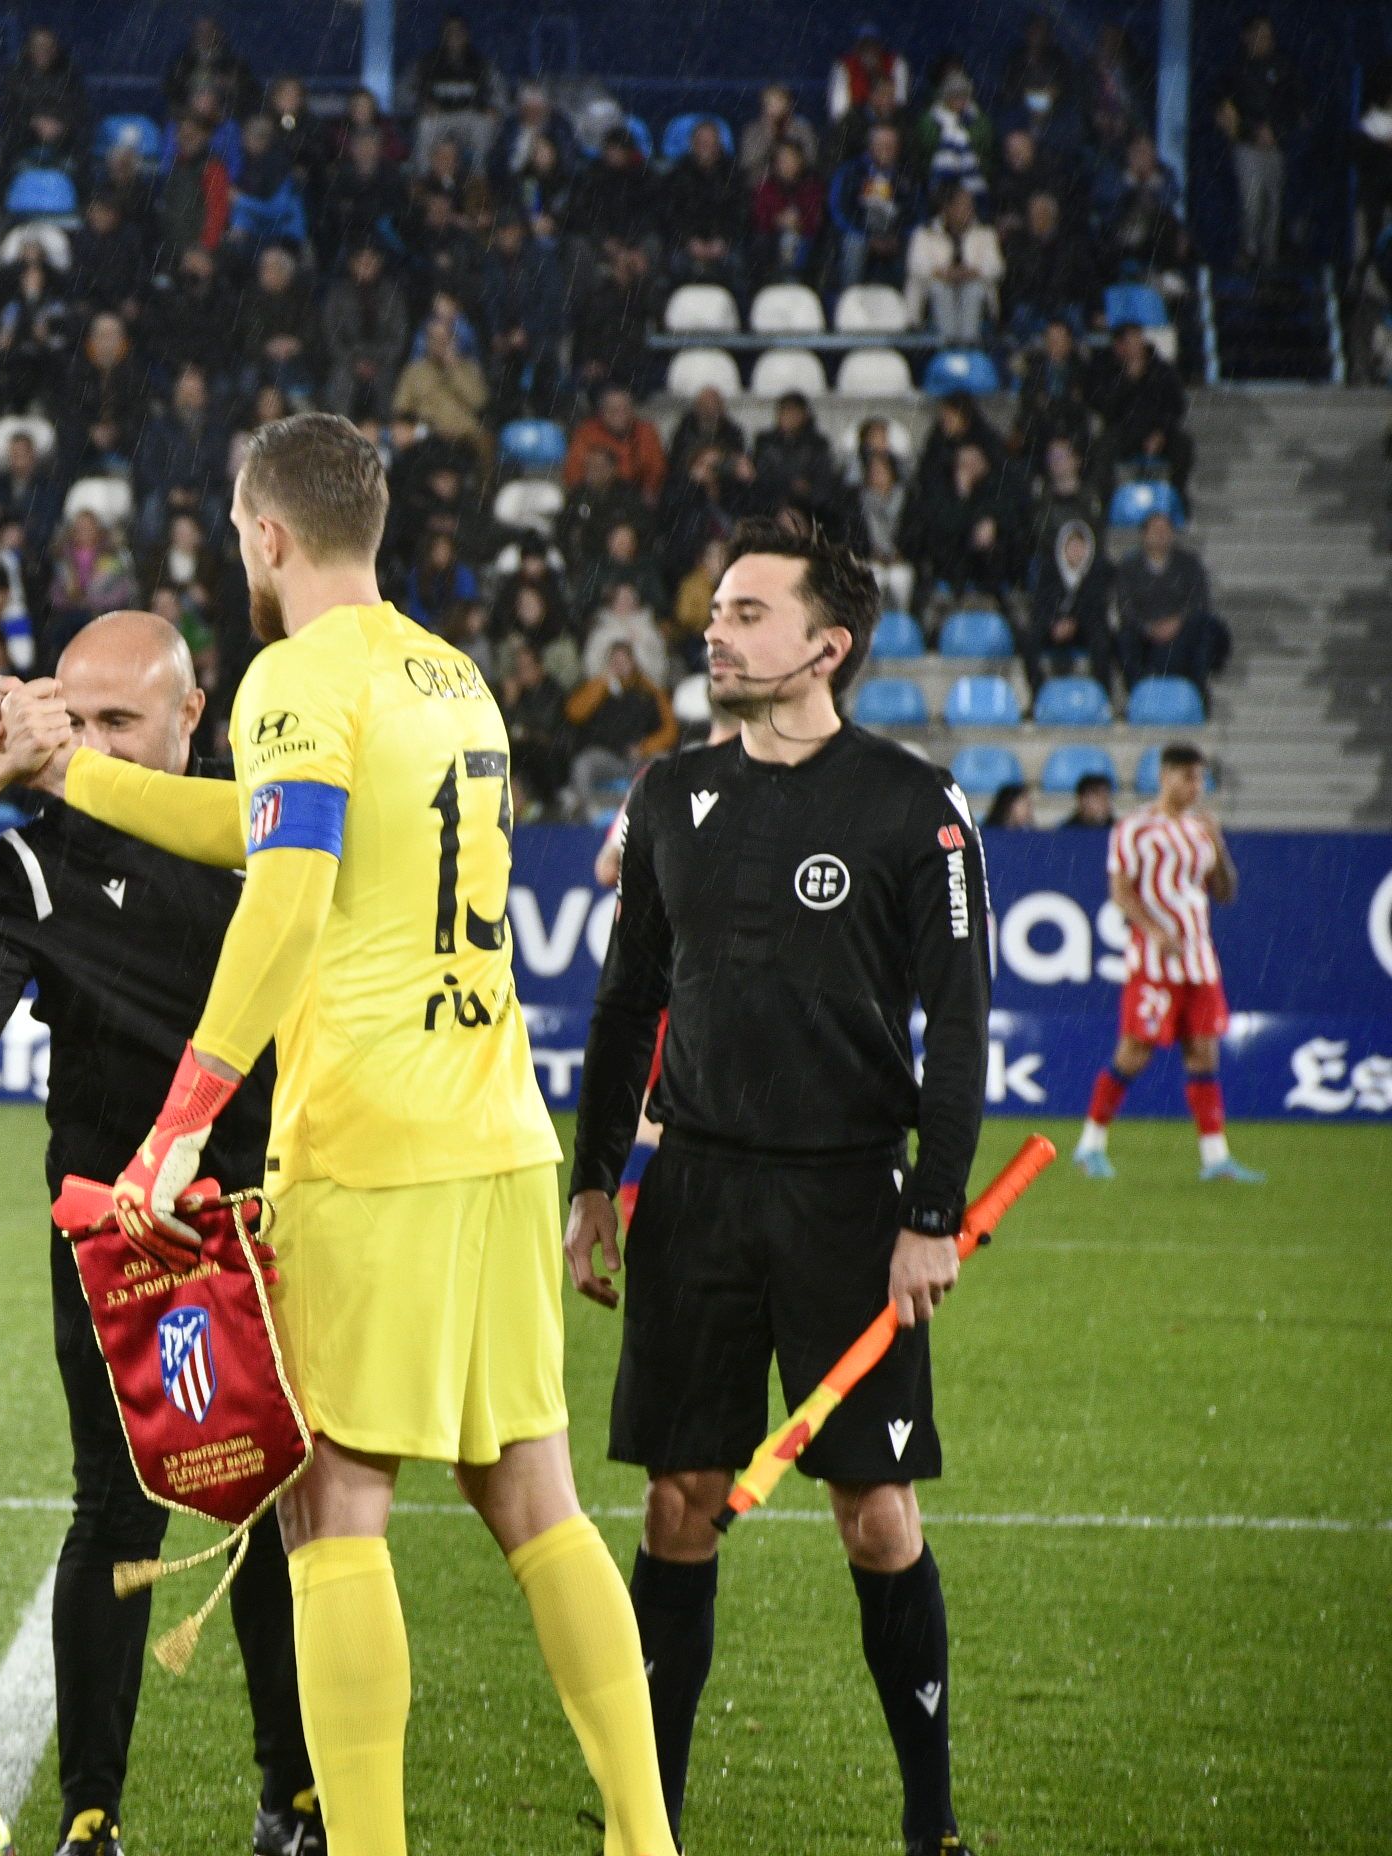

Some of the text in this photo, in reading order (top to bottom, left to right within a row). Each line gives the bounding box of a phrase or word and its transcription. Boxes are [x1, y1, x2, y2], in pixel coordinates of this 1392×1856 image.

[248, 739, 316, 777] HYUNDAI
[429, 750, 512, 955] 13
[947, 850, 969, 939] WÜRTH
[124, 1258, 159, 1281] CEN
